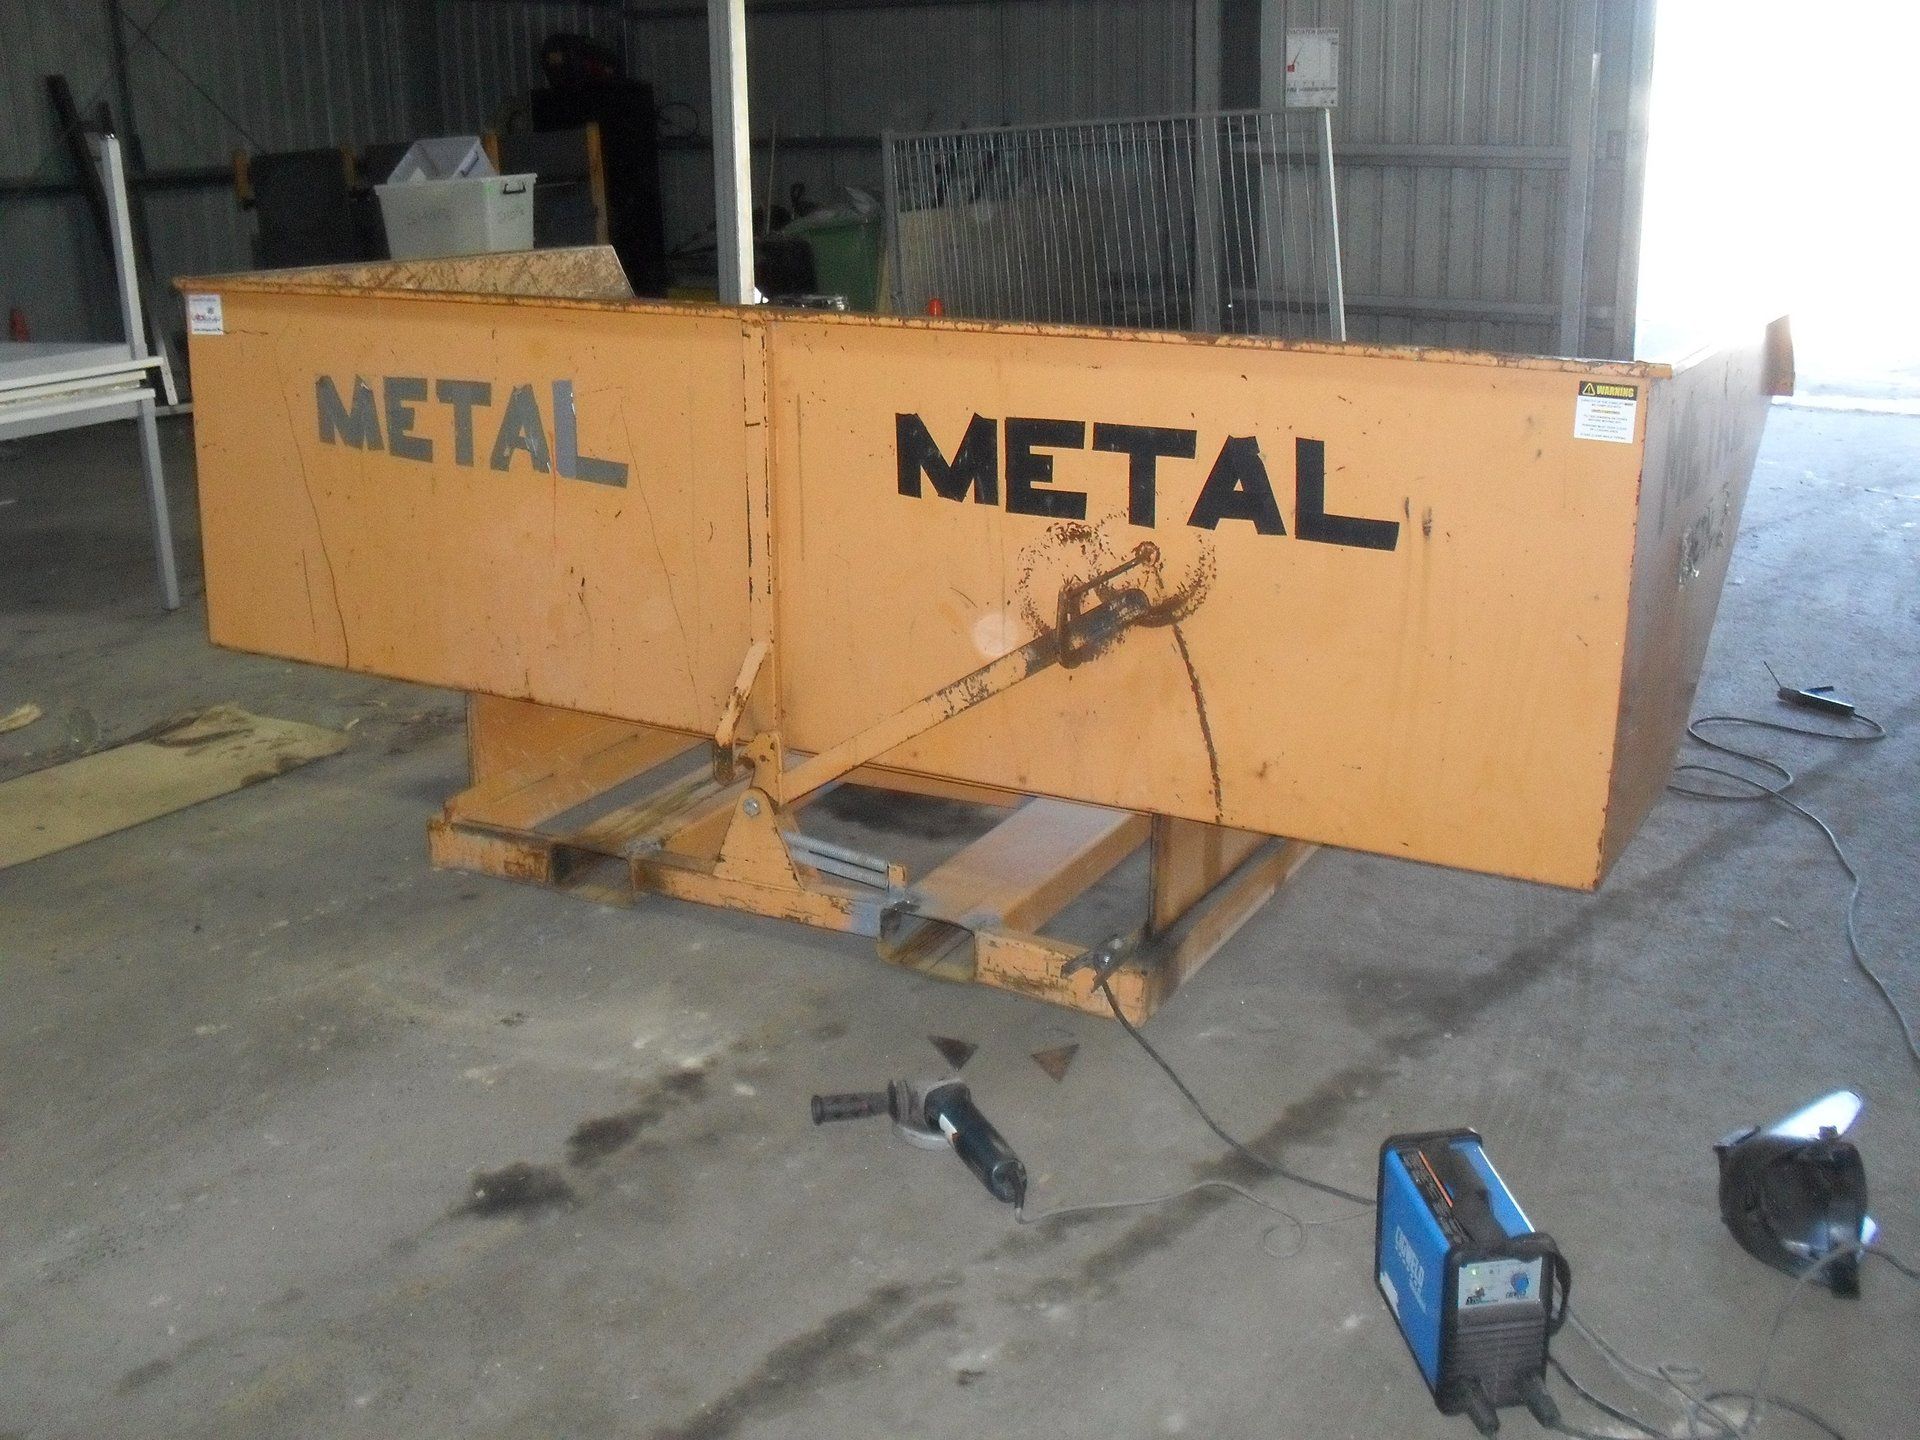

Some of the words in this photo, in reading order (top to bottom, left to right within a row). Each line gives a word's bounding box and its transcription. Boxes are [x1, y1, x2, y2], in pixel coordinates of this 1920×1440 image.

[315, 374, 629, 488] METAL
[1596, 385, 1634, 398] WARNING
[895, 412, 1400, 551] METAL
